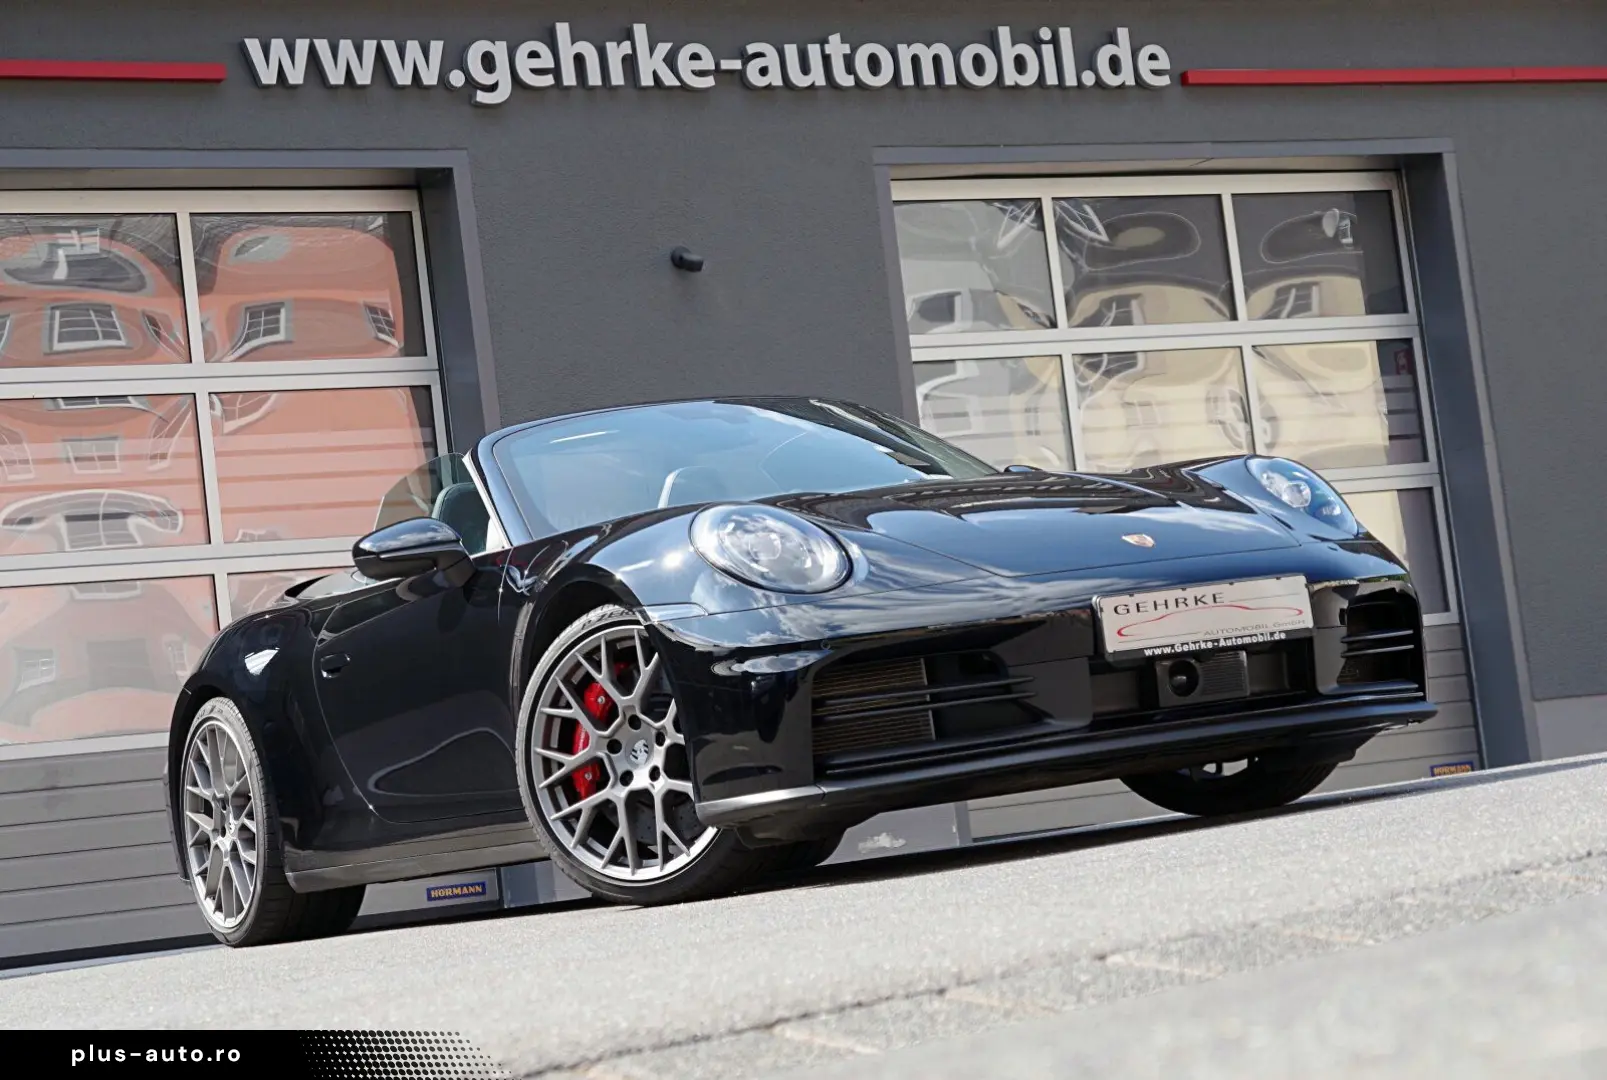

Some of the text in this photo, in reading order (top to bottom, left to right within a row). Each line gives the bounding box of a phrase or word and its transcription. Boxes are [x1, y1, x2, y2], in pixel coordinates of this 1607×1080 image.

[242, 21, 1171, 105] www.gehrke-automobil.de
[1113, 591, 1225, 616] GEHRKE
[1203, 623, 1268, 637] AUTOMOBIL
[1143, 631, 1287, 656] www.Gehrke-Automobil.de
